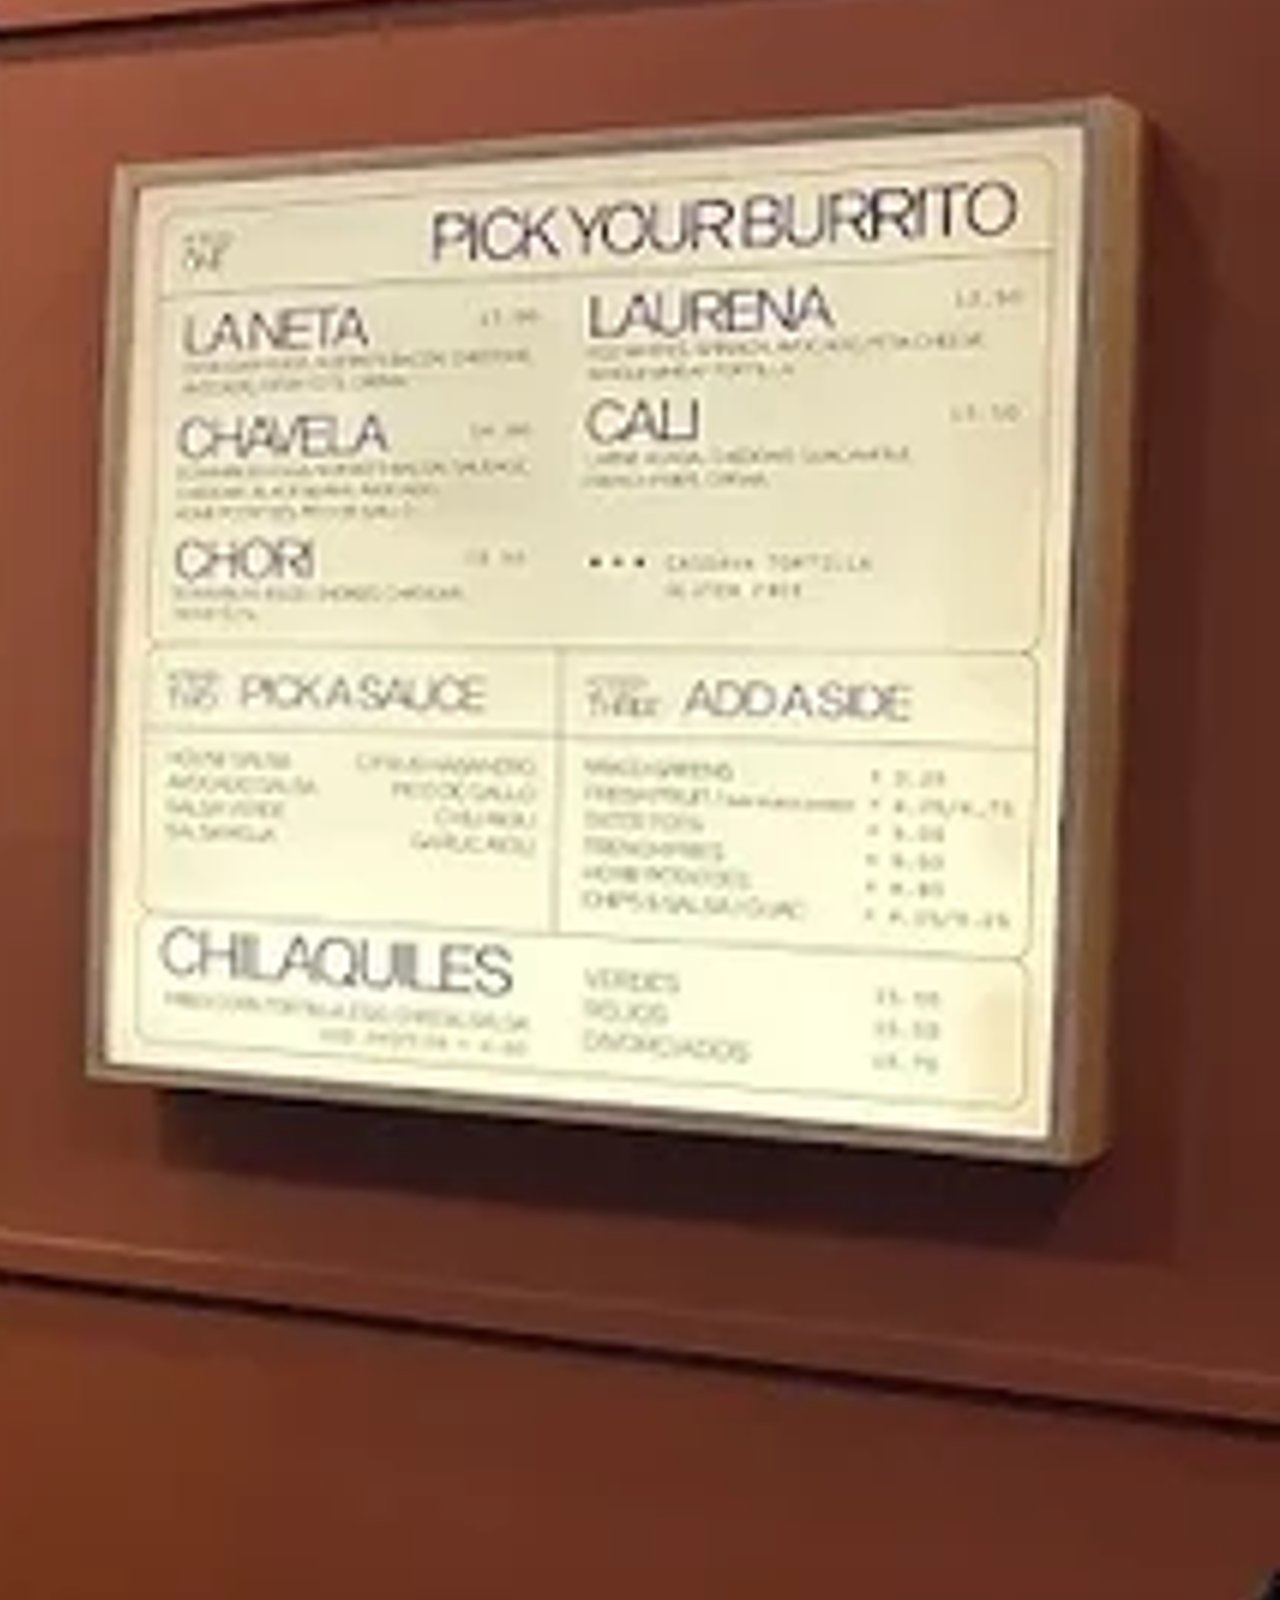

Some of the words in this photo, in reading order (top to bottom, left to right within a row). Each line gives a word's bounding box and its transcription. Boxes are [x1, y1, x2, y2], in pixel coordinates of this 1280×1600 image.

[431, 203, 563, 264] PICK
[565, 194, 736, 258] YOUR
[740, 179, 1021, 250] BURRITO
[182, 310, 244, 357] LA
[247, 305, 371, 355] NETA
[587, 283, 836, 339] LAURENA
[178, 411, 390, 459] CHAVELA
[584, 395, 701, 443] CALI
[175, 537, 315, 580] CHORI
[241, 671, 322, 710] PICK
[360, 673, 487, 713] SAUCE
[683, 679, 778, 720] ADD
[781, 681, 812, 721] A
[817, 681, 913, 723] SIDE
[159, 925, 515, 999] CHILAQUILES
